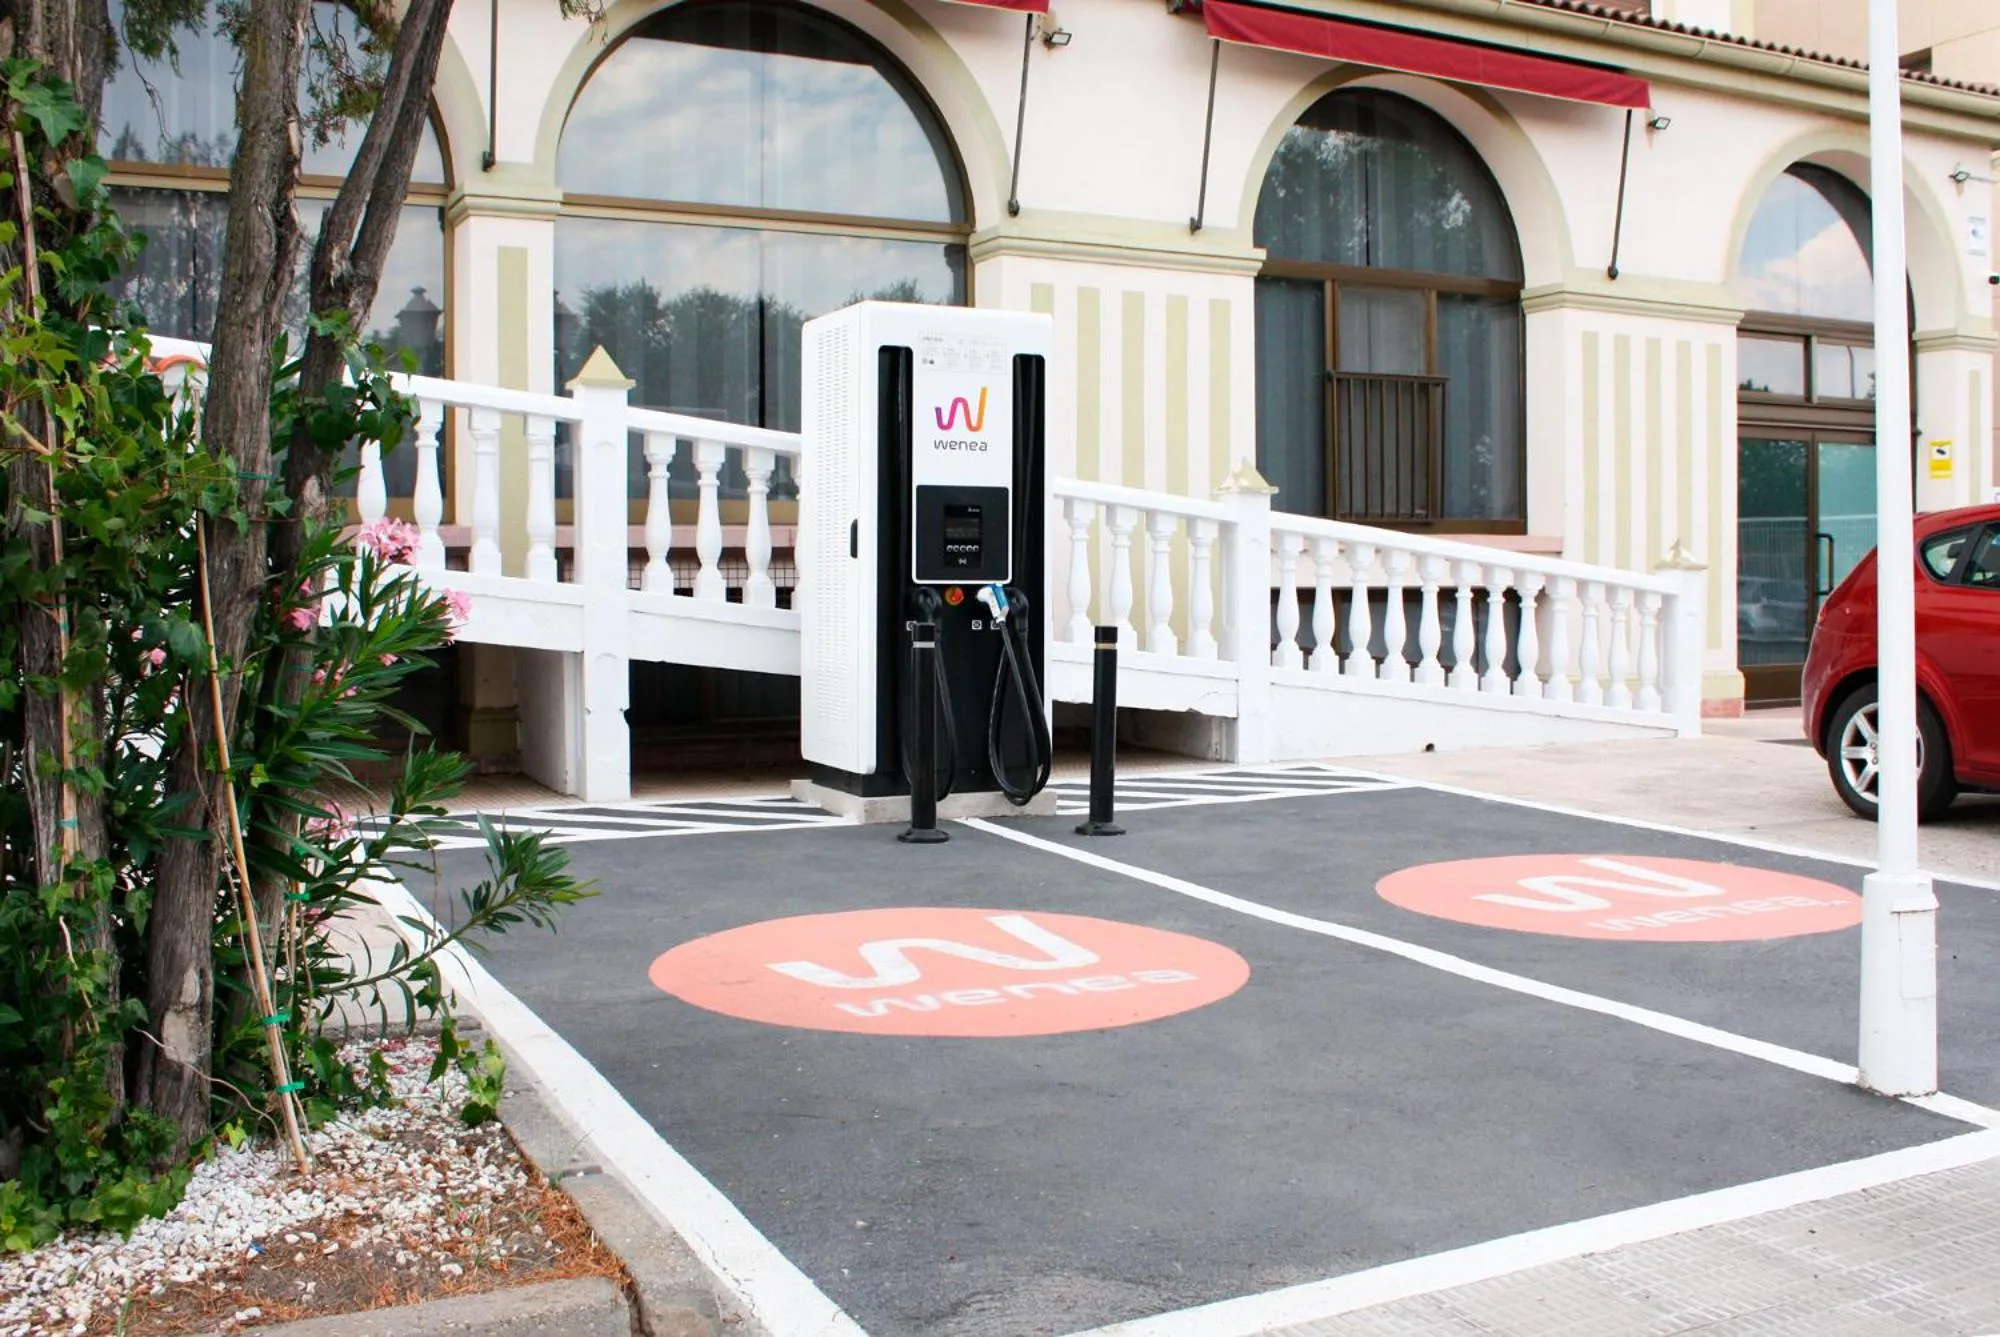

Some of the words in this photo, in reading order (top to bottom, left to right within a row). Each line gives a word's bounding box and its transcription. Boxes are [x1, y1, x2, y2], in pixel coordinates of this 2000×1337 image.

[934, 439, 988, 452] wenea
[1587, 895, 1821, 932] wenea
[834, 969, 1200, 1018] wenea
